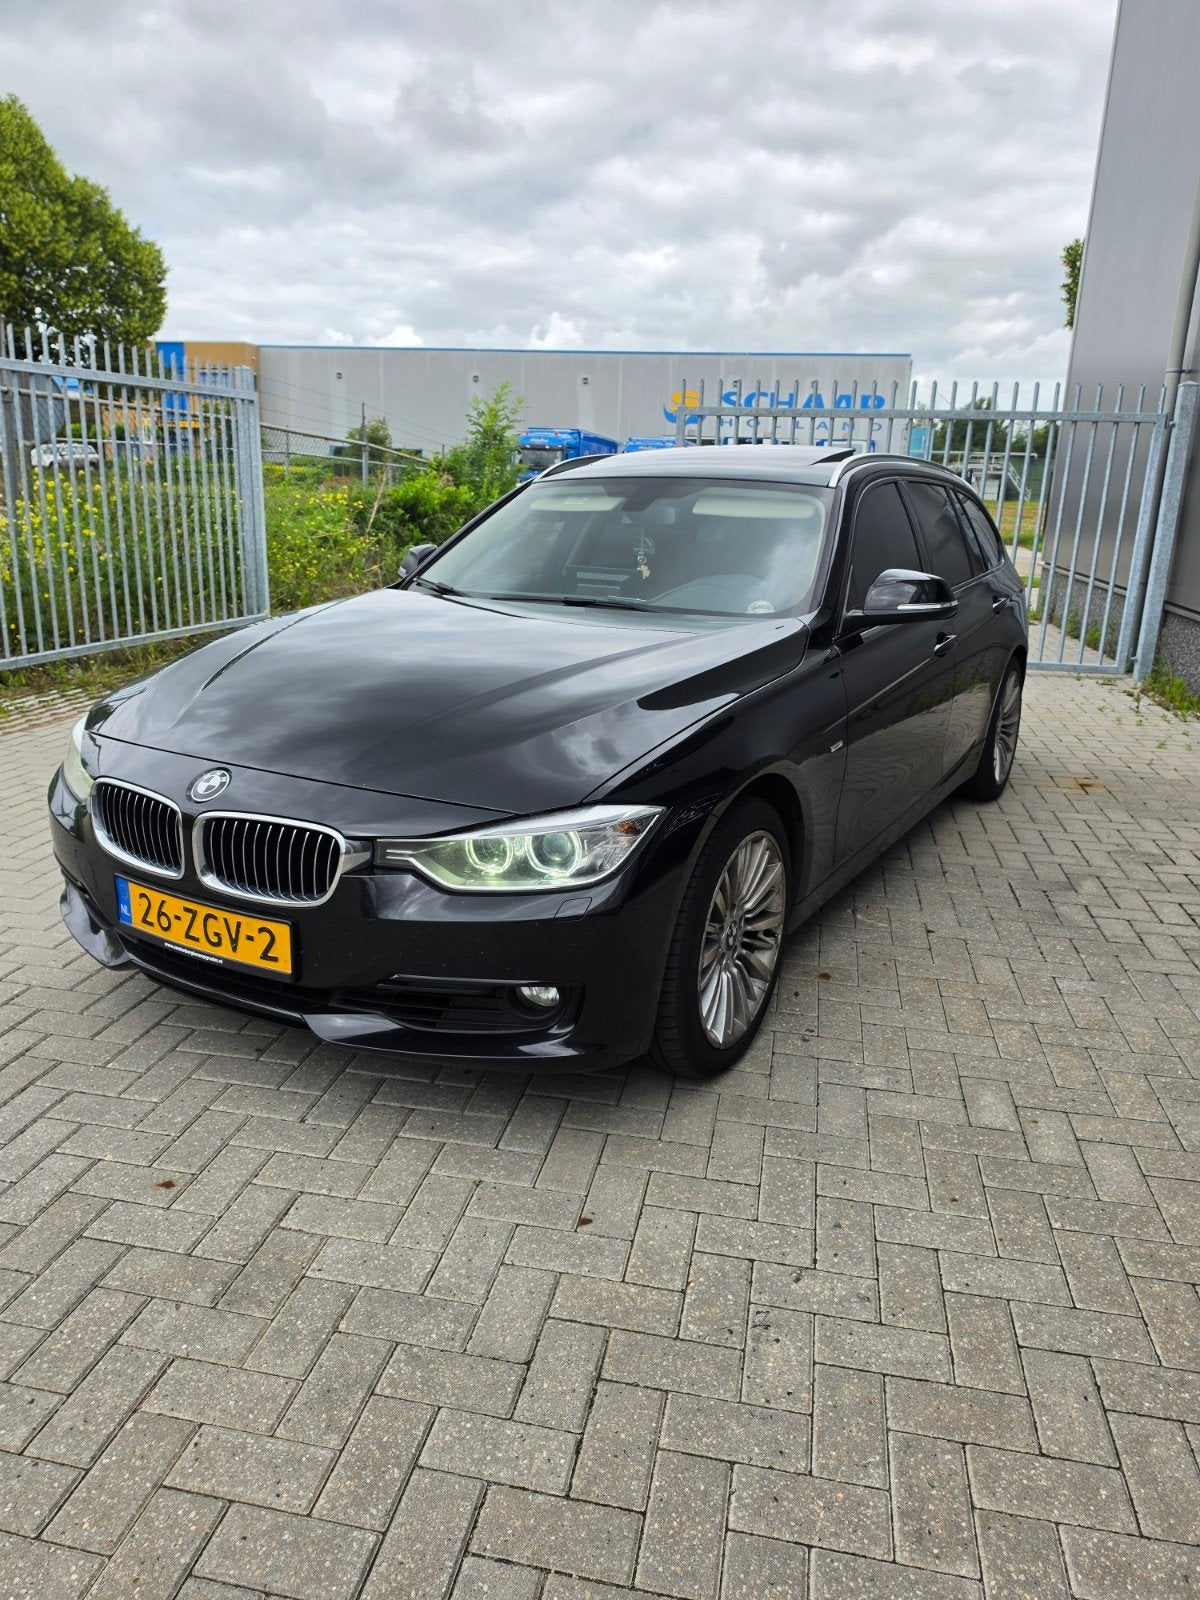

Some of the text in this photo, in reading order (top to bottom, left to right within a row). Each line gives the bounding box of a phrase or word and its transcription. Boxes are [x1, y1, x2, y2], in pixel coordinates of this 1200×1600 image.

[721, 391, 887, 411] SCHAAP
[120, 903, 131, 916] NL
[138, 892, 279, 962] 26-ZGV-2
